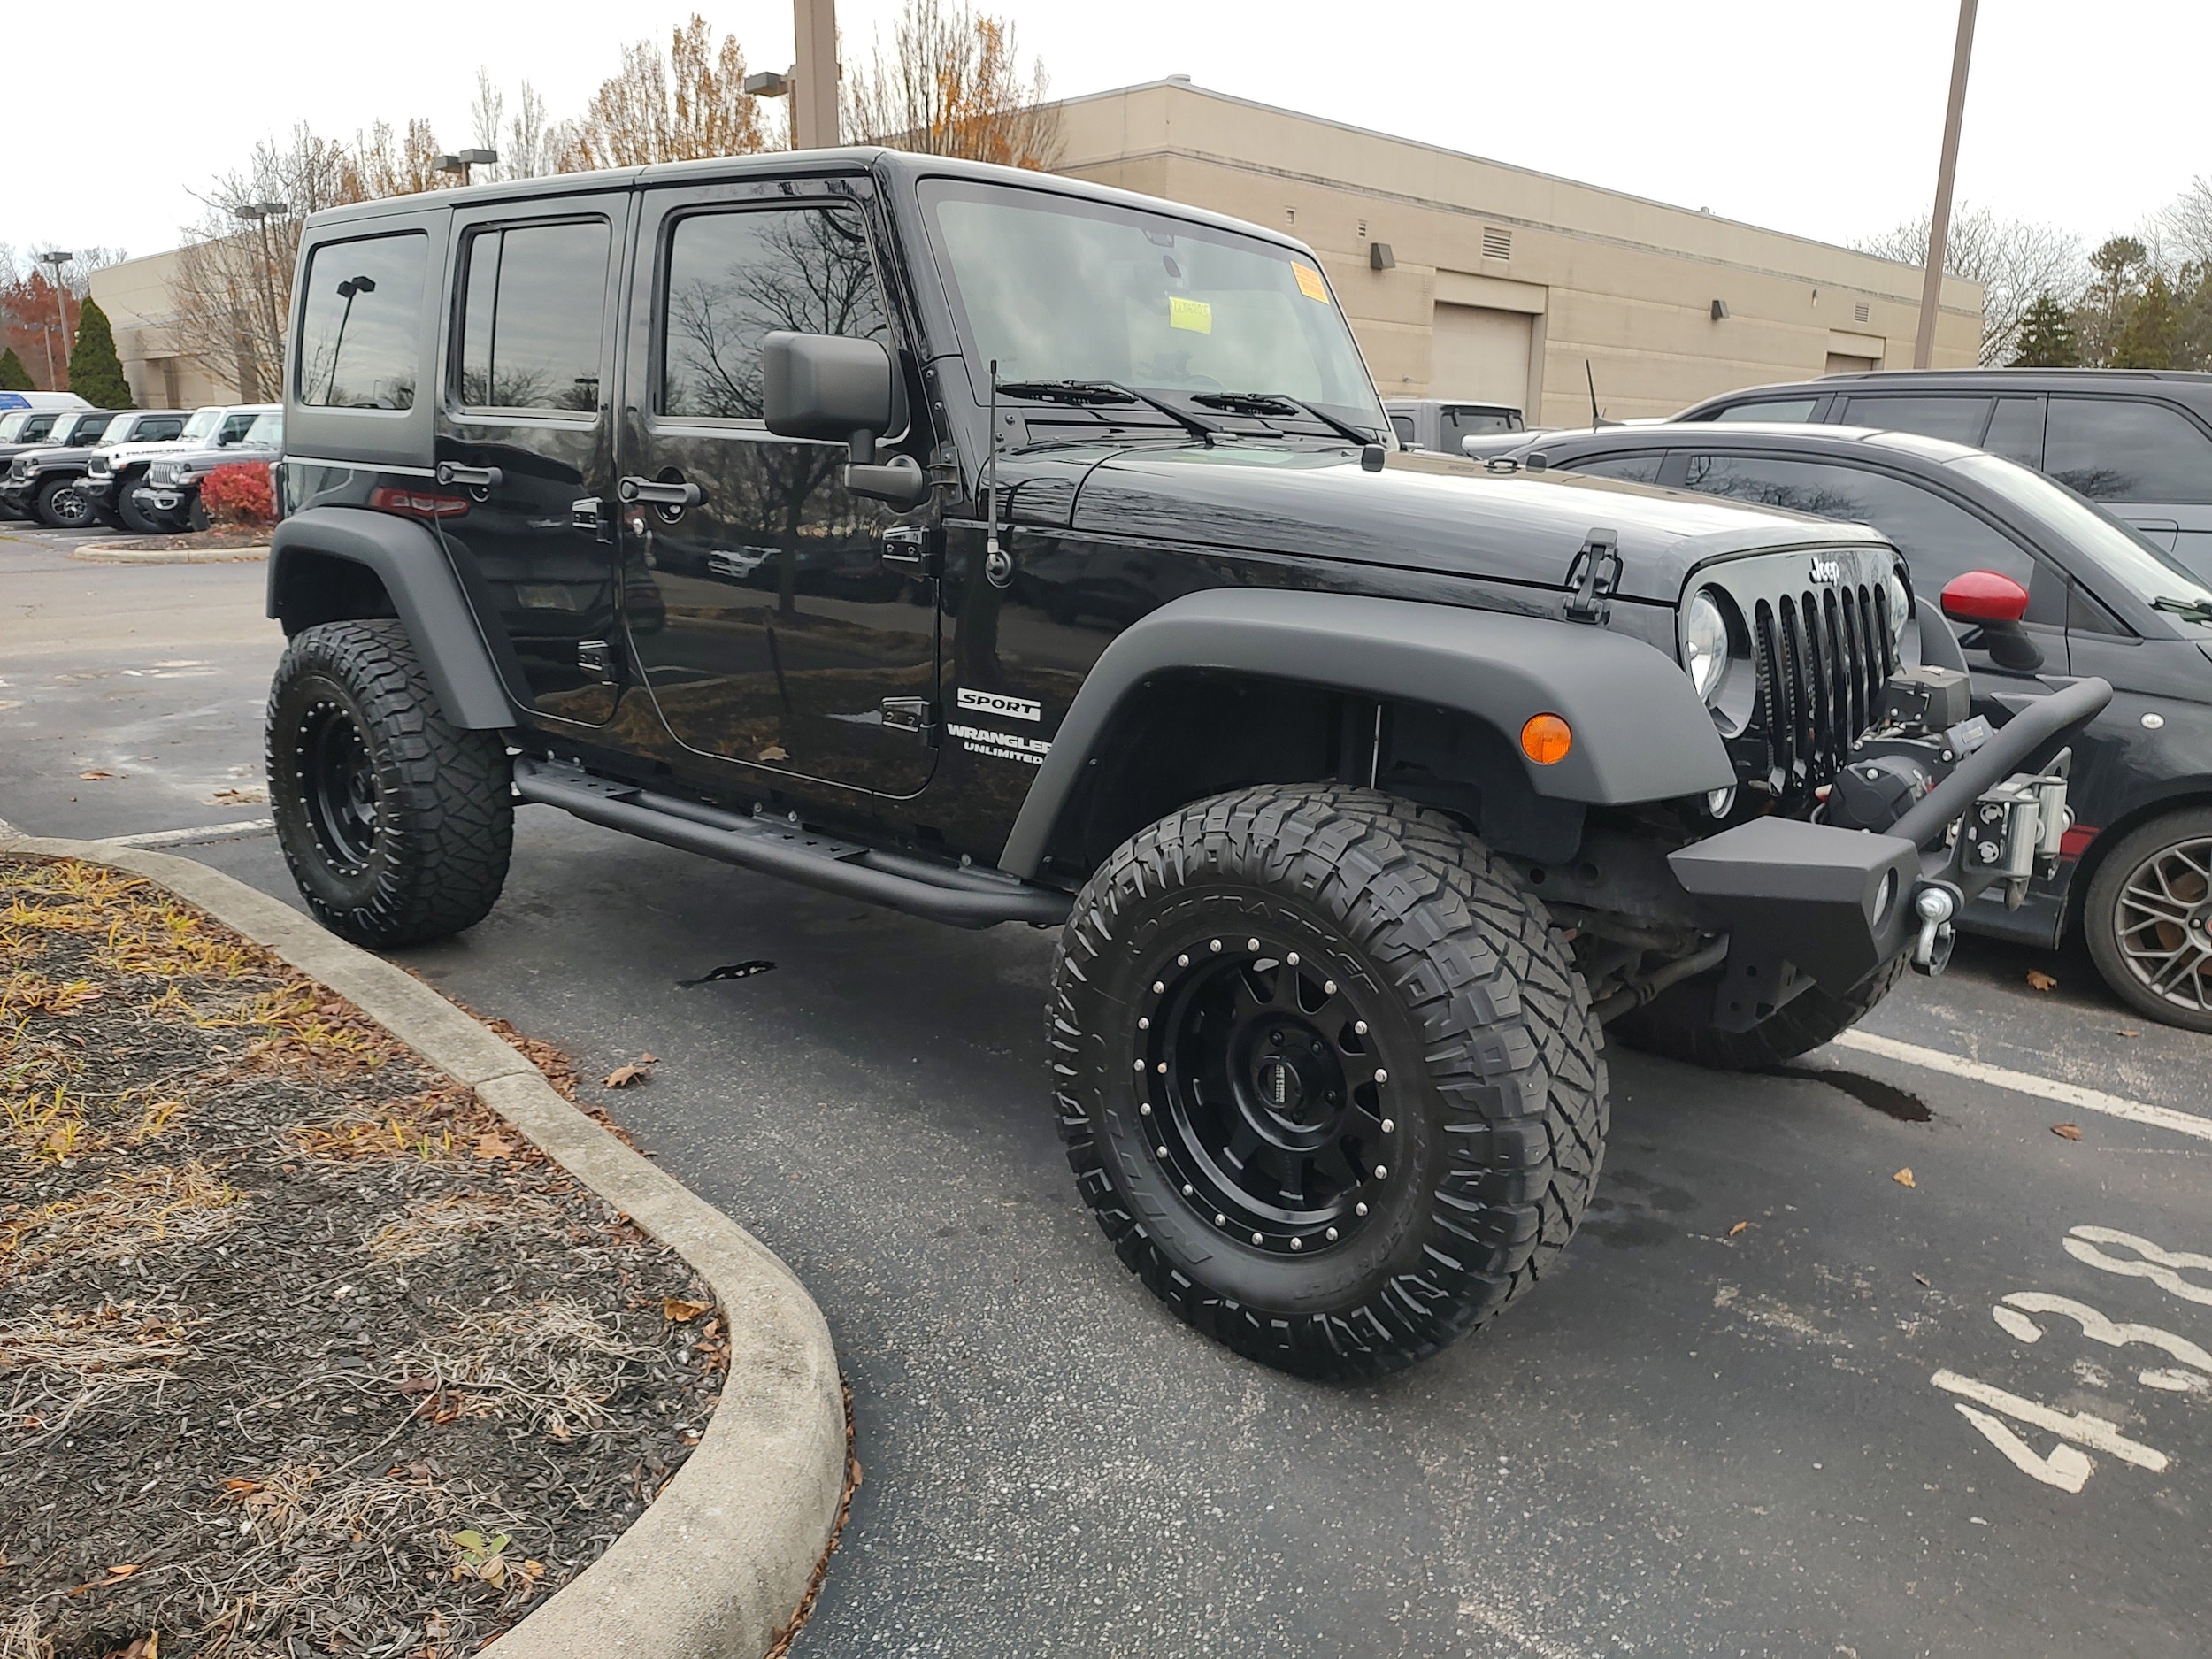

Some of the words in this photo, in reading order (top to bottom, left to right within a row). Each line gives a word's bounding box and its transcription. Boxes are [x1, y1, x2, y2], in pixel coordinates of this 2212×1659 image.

[1810, 557, 1839, 587] Jeep
[963, 694, 1033, 715] SPORT
[964, 741, 1044, 765] UNLIMITED
